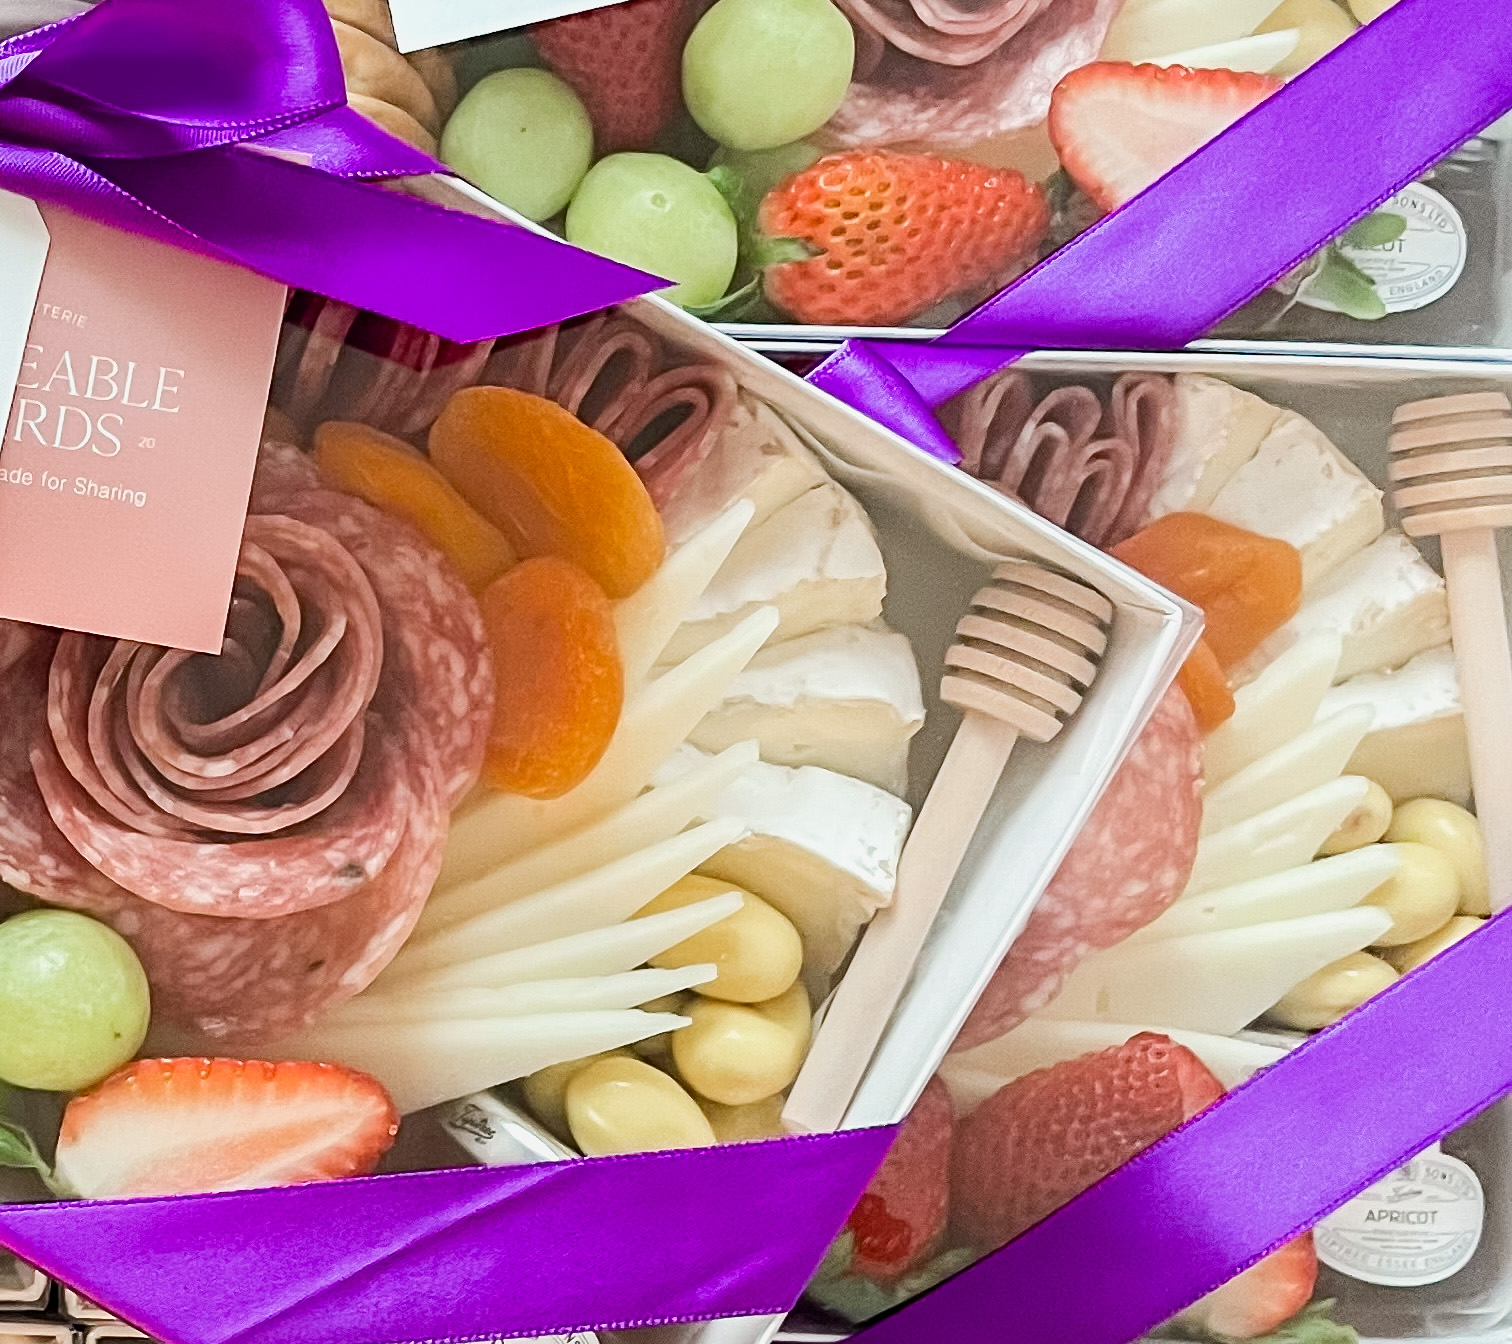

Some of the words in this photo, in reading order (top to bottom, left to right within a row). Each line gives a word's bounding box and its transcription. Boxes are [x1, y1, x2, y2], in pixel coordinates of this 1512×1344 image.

[41, 471, 67, 491] for
[74, 477, 147, 507] Sharing
[1365, 1209, 1438, 1224] APRICOT
